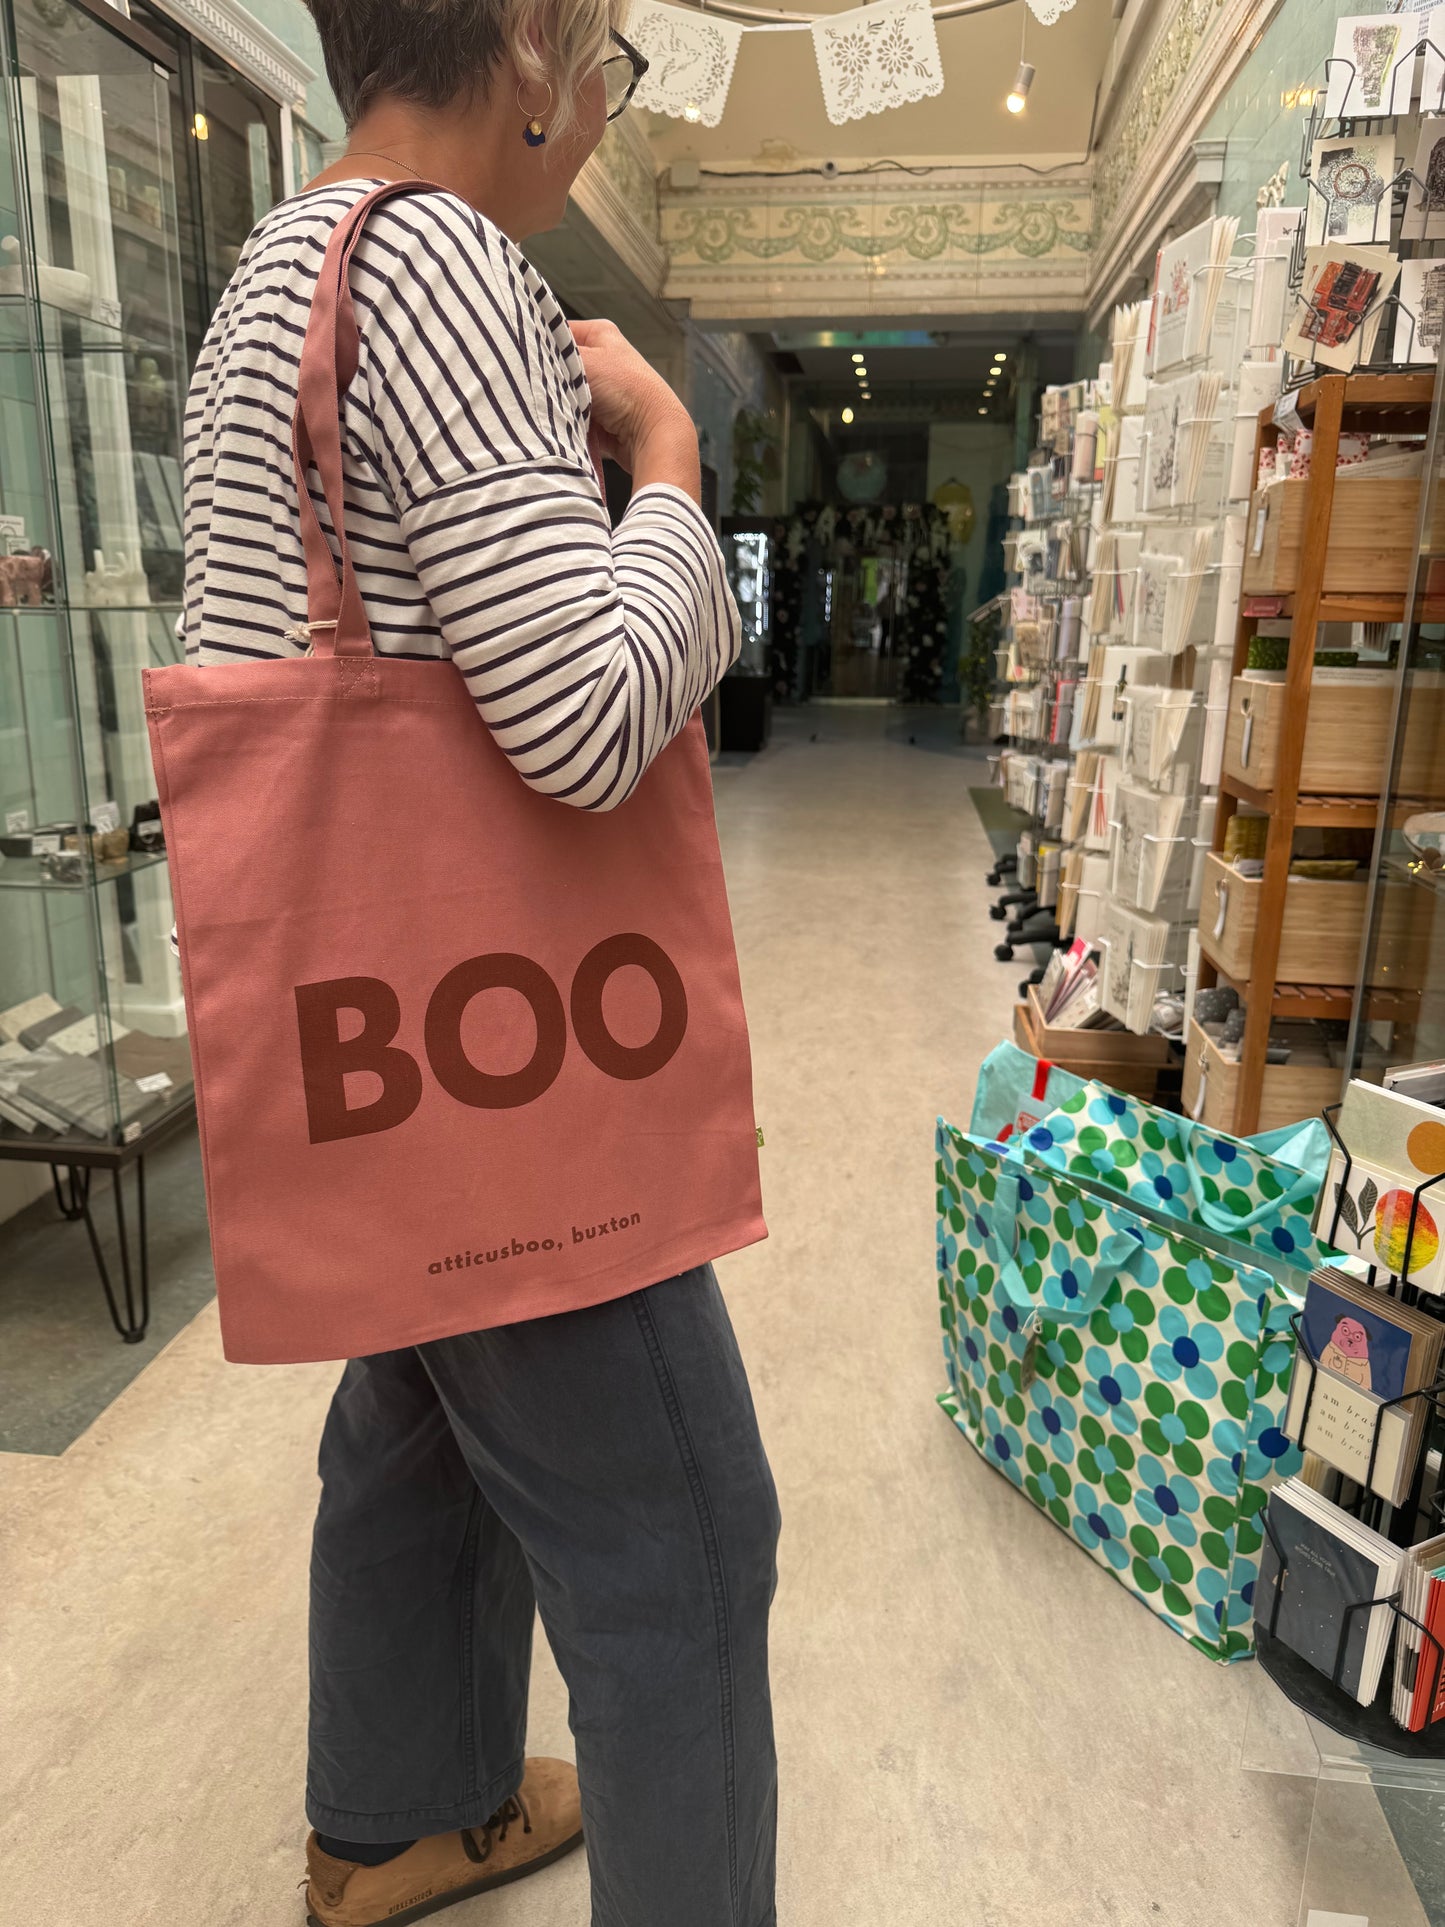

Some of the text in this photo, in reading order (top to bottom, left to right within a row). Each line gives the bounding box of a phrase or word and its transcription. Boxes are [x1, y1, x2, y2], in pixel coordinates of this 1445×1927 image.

[294, 932, 688, 1145] BOO
[428, 1212, 641, 1275] atticusboo, buxton
[1346, 1405, 1377, 1428] brav
[1343, 1421, 1373, 1443] brav
[1340, 1437, 1370, 1460] brav
